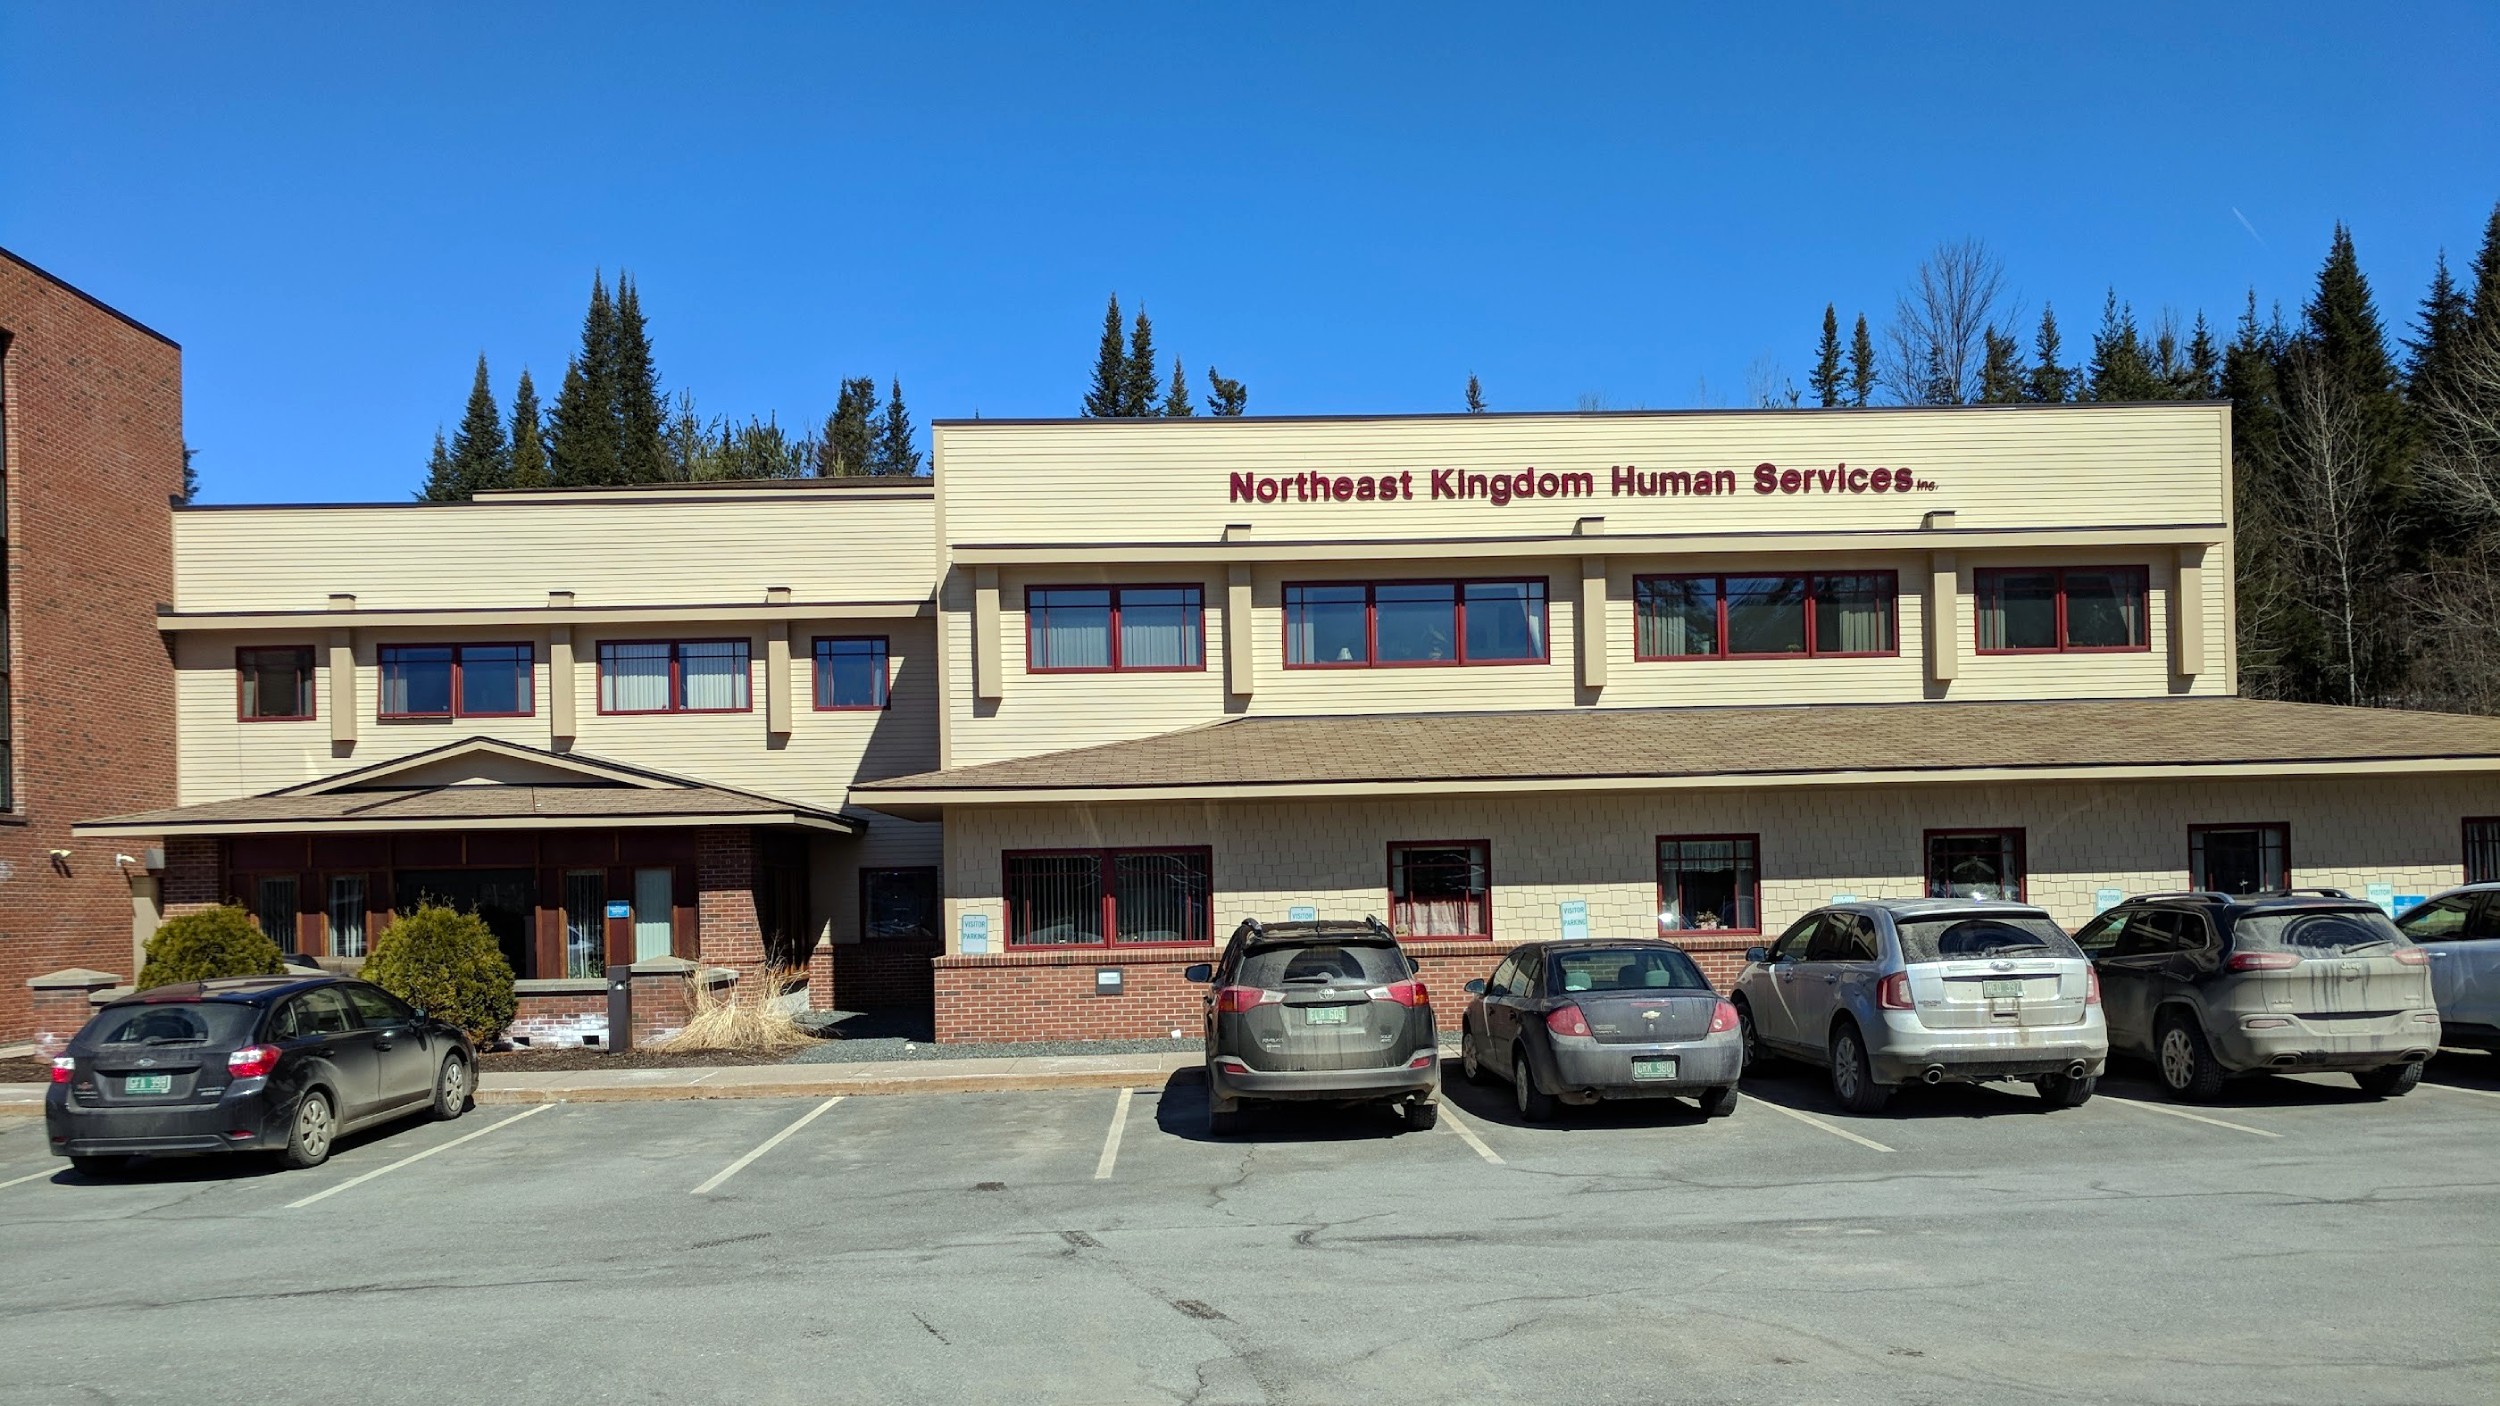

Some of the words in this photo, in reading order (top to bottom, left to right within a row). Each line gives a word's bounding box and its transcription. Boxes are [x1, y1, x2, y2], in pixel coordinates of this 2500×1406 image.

[1230, 470, 1413, 503] Northeast
[1431, 467, 1594, 506] Kingdom
[1611, 465, 1736, 496] Human
[1753, 463, 1914, 494] Services
[1563, 907, 1584, 915] VISITOR
[2341, 961, 2362, 970] Jeep
[1329, 1009, 1344, 1020] 609
[1637, 1062, 1652, 1073] GRK
[1656, 1062, 1672, 1073] 980
